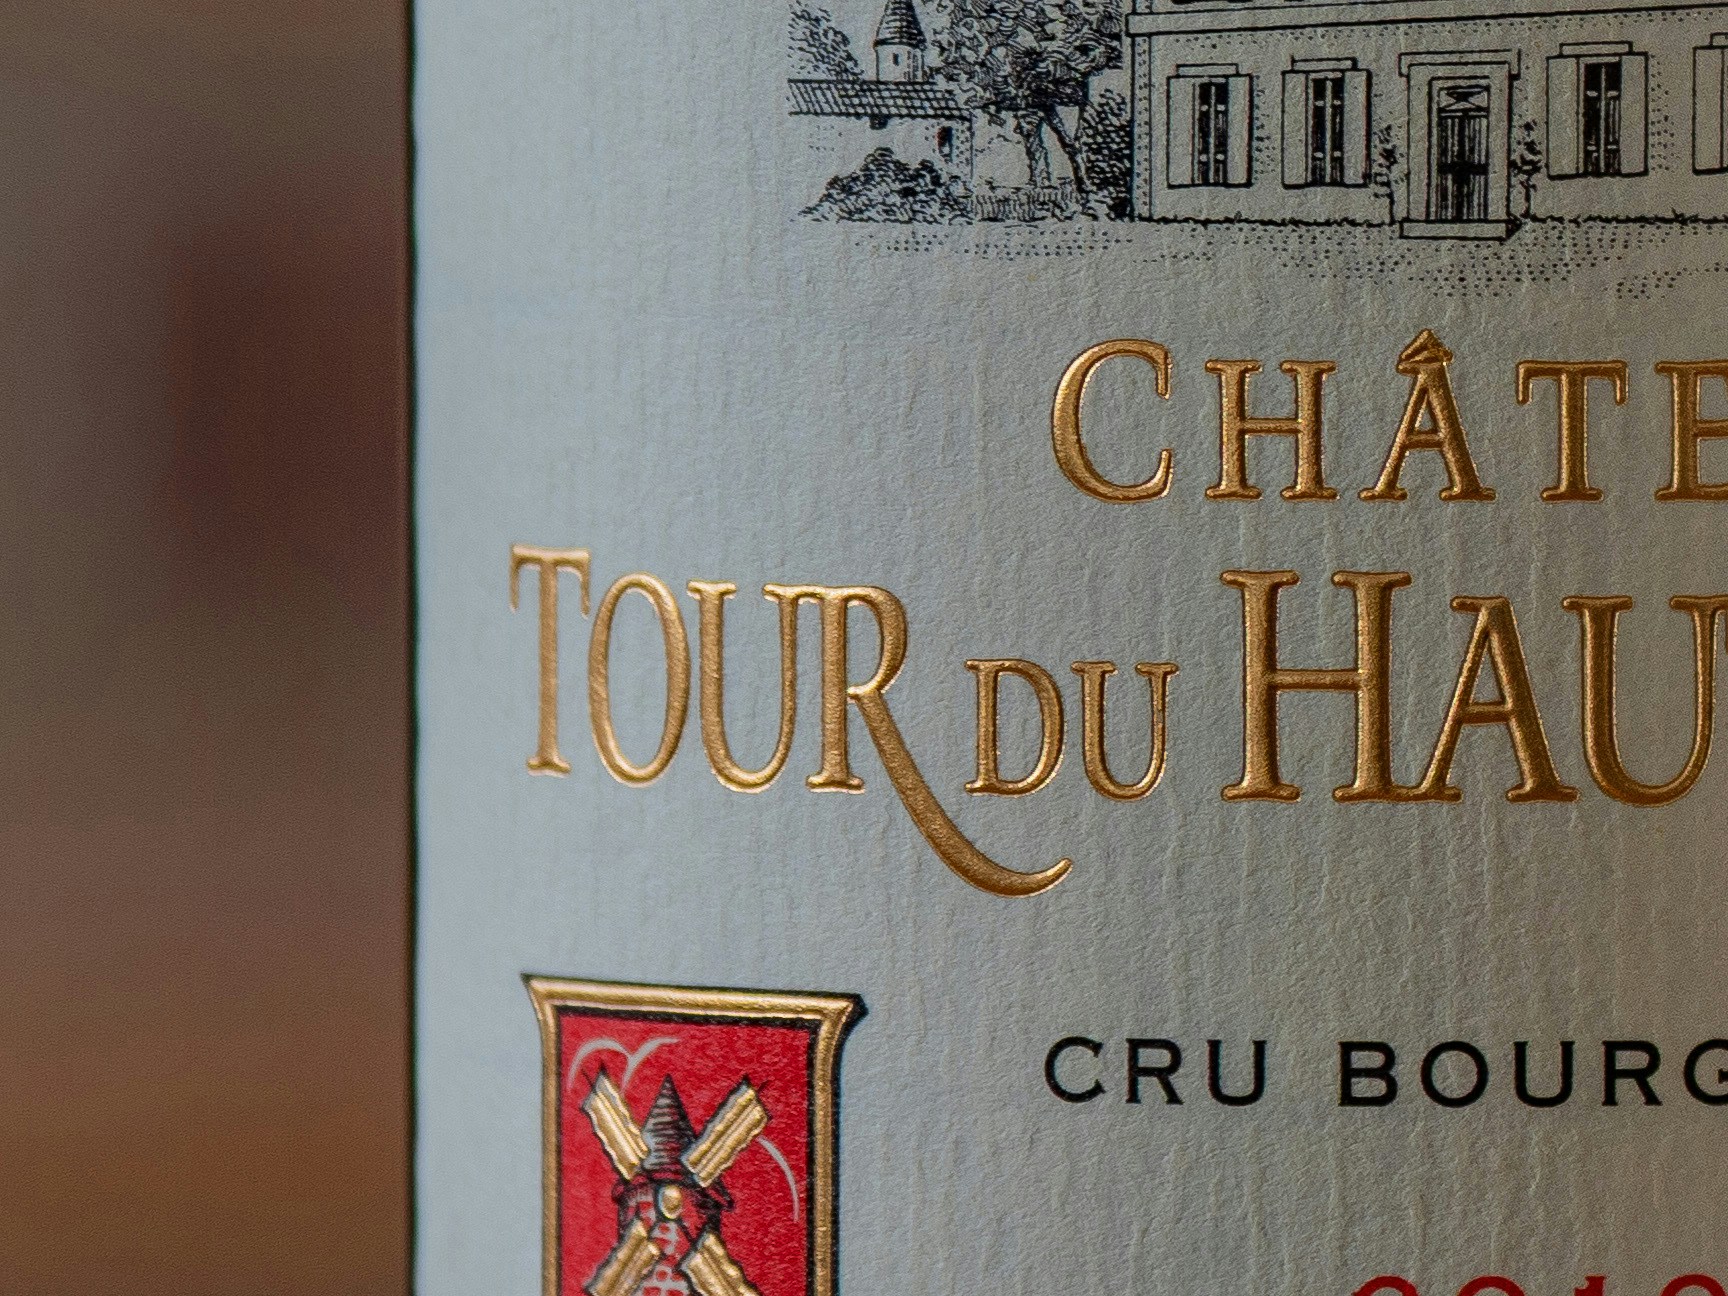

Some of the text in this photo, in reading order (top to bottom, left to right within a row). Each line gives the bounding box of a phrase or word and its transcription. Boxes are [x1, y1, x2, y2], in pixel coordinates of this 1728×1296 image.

[510, 547, 1074, 897] TOUR
[966, 659, 1177, 801] DU
[1044, 1036, 1266, 1107] CRU
